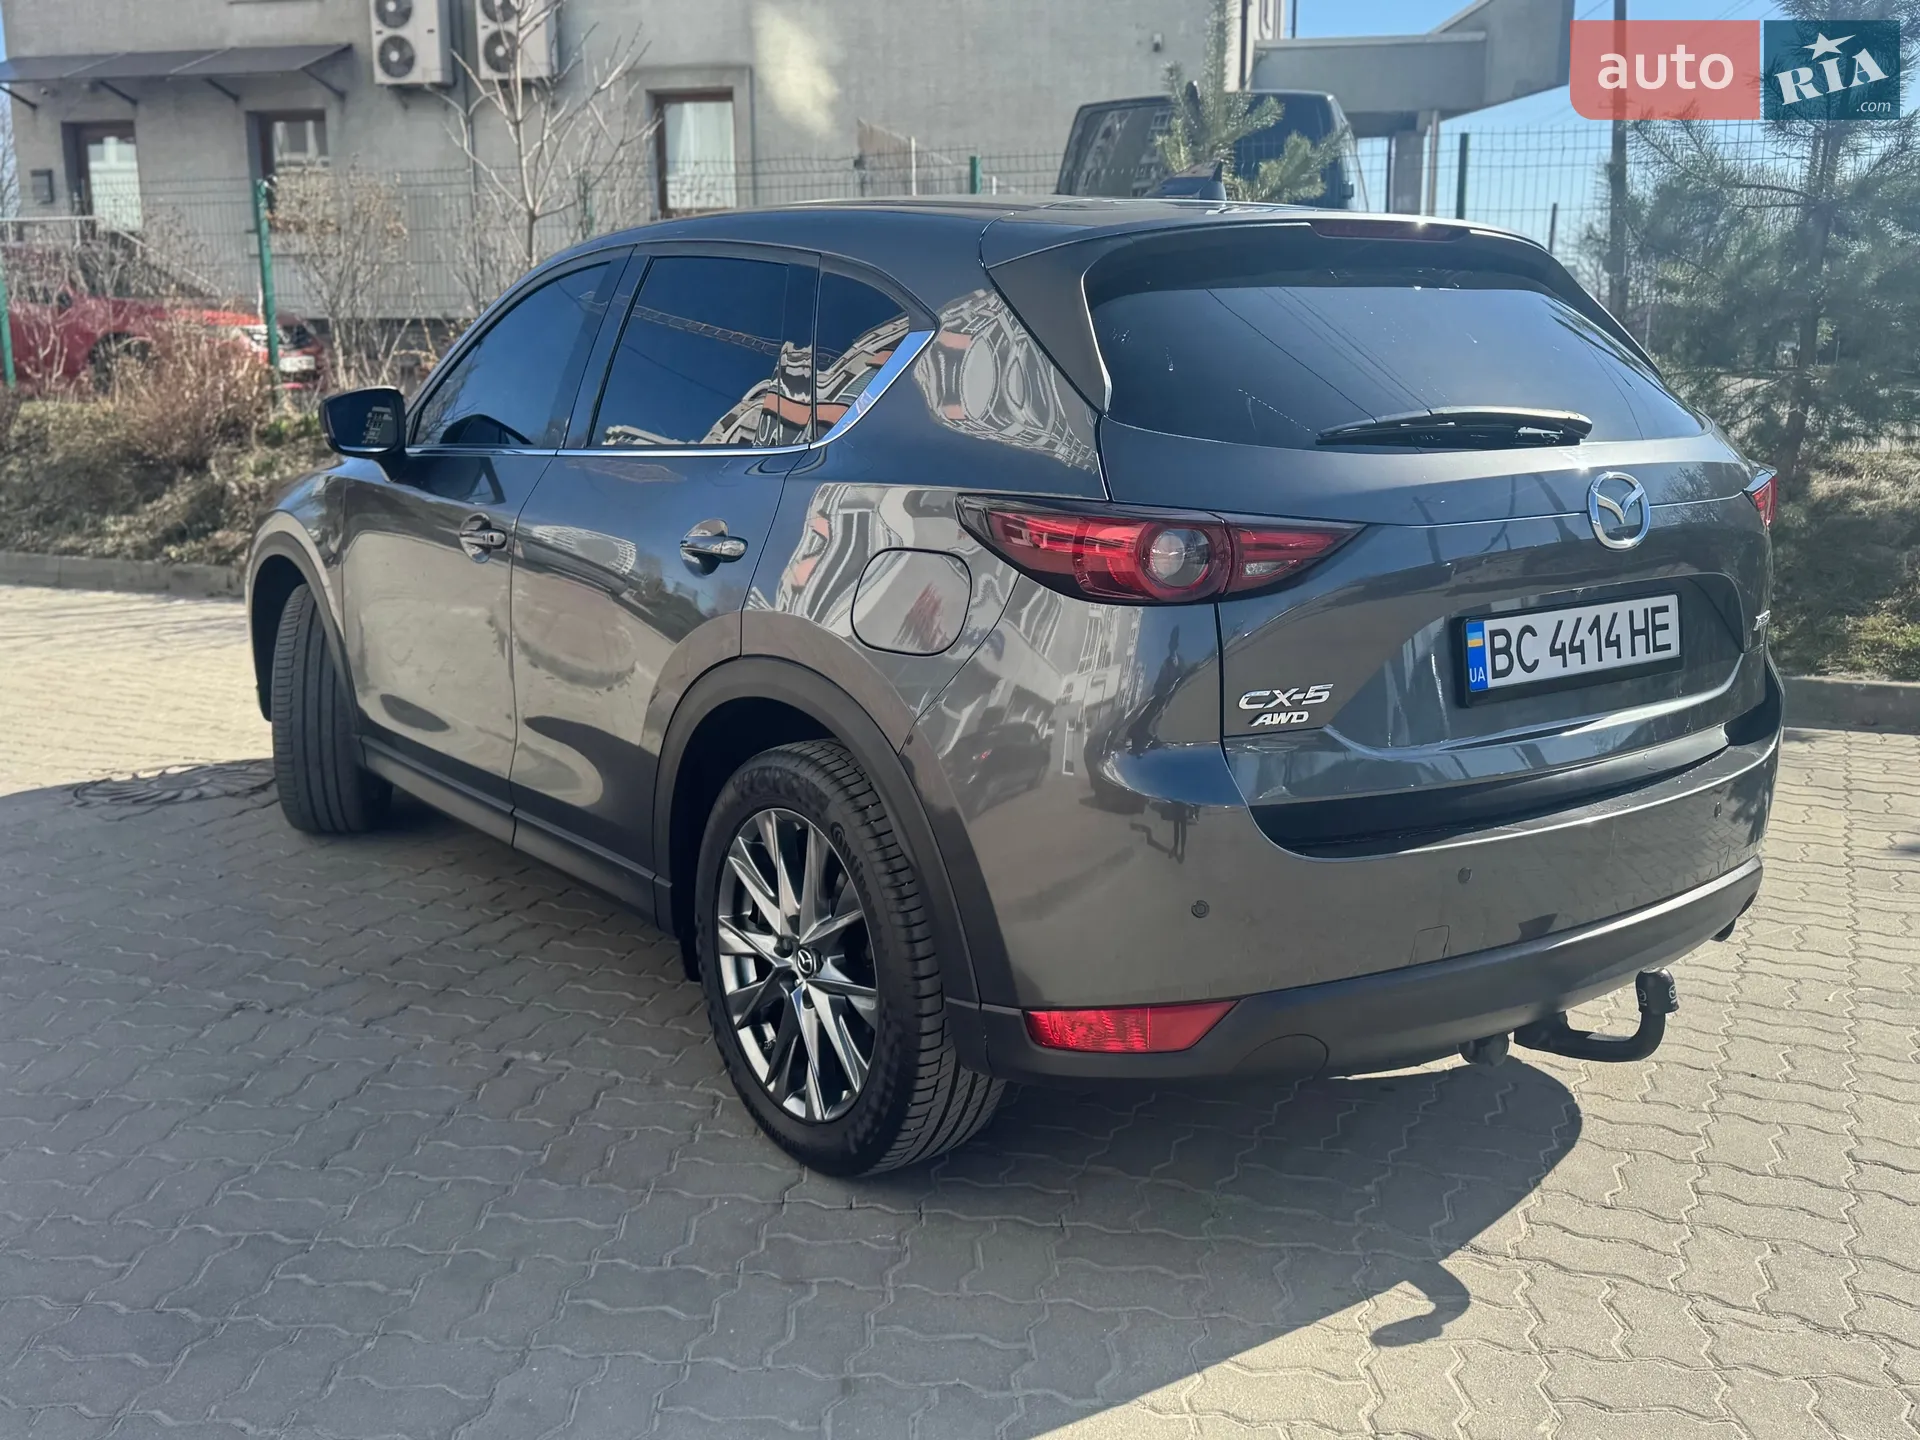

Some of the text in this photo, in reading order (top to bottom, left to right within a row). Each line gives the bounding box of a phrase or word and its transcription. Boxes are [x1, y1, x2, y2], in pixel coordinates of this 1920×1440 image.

[1488, 604, 1672, 680] BC 4414 HE
[1469, 666, 1486, 683] UA
[1238, 683, 1334, 710] CX-5
[1250, 711, 1309, 727] AWD
